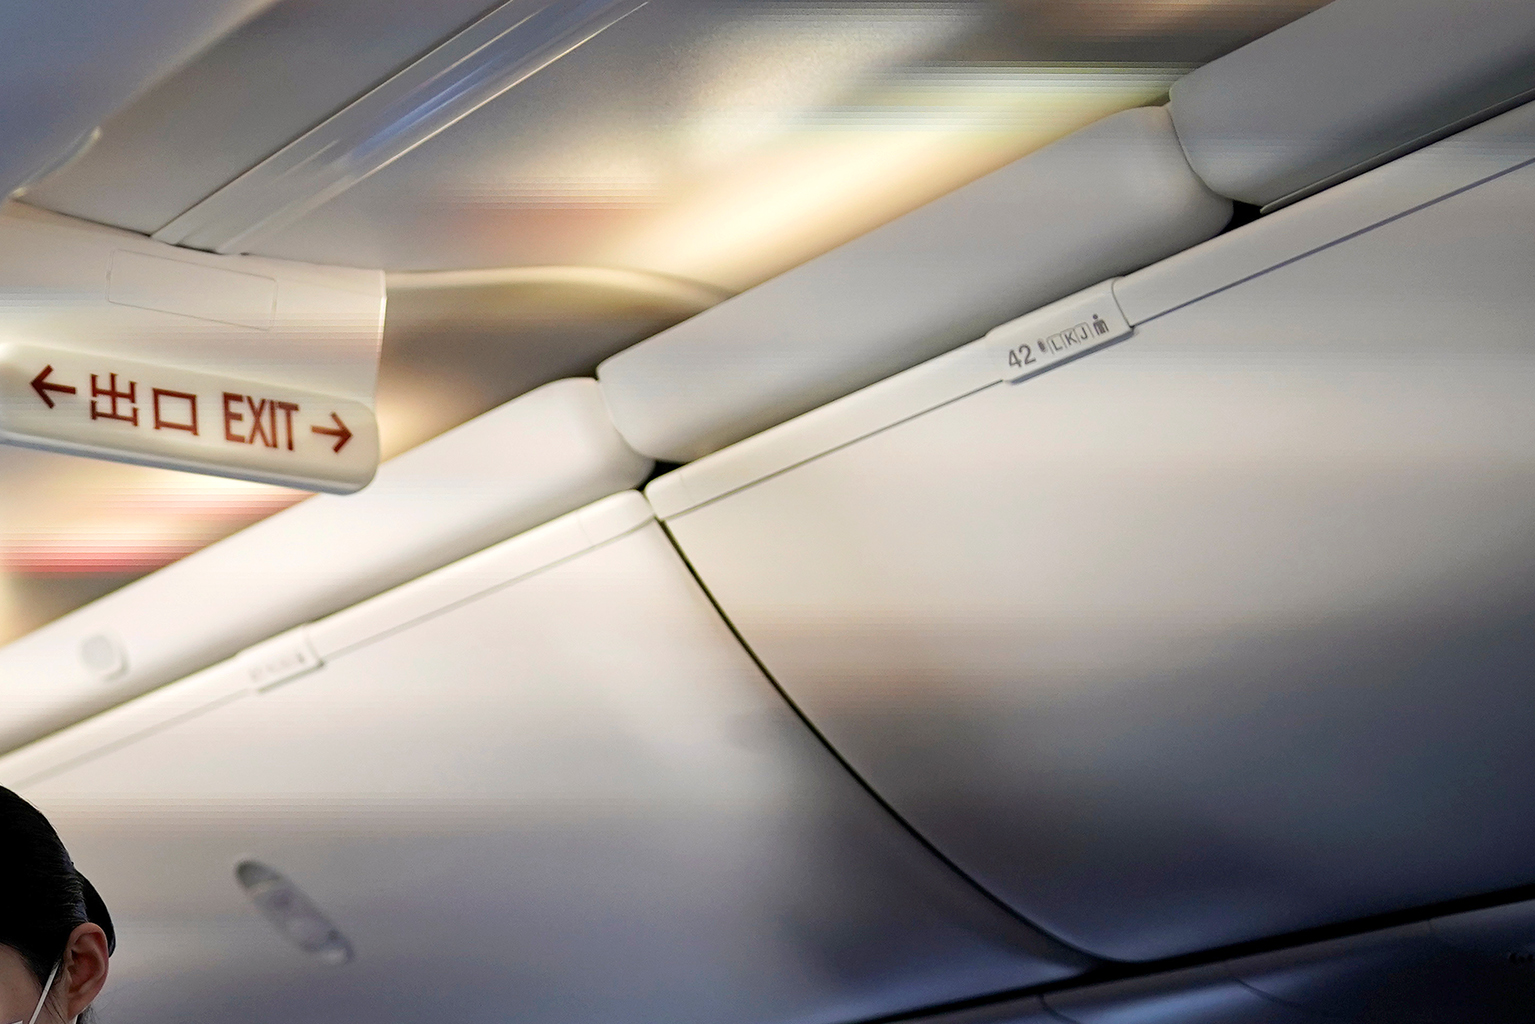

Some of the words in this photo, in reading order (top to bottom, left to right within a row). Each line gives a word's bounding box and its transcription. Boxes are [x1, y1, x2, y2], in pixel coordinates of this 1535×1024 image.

[1008, 344, 1036, 368] 42
[90, 371, 200, 437] 出口
[223, 391, 299, 452] EXIT
